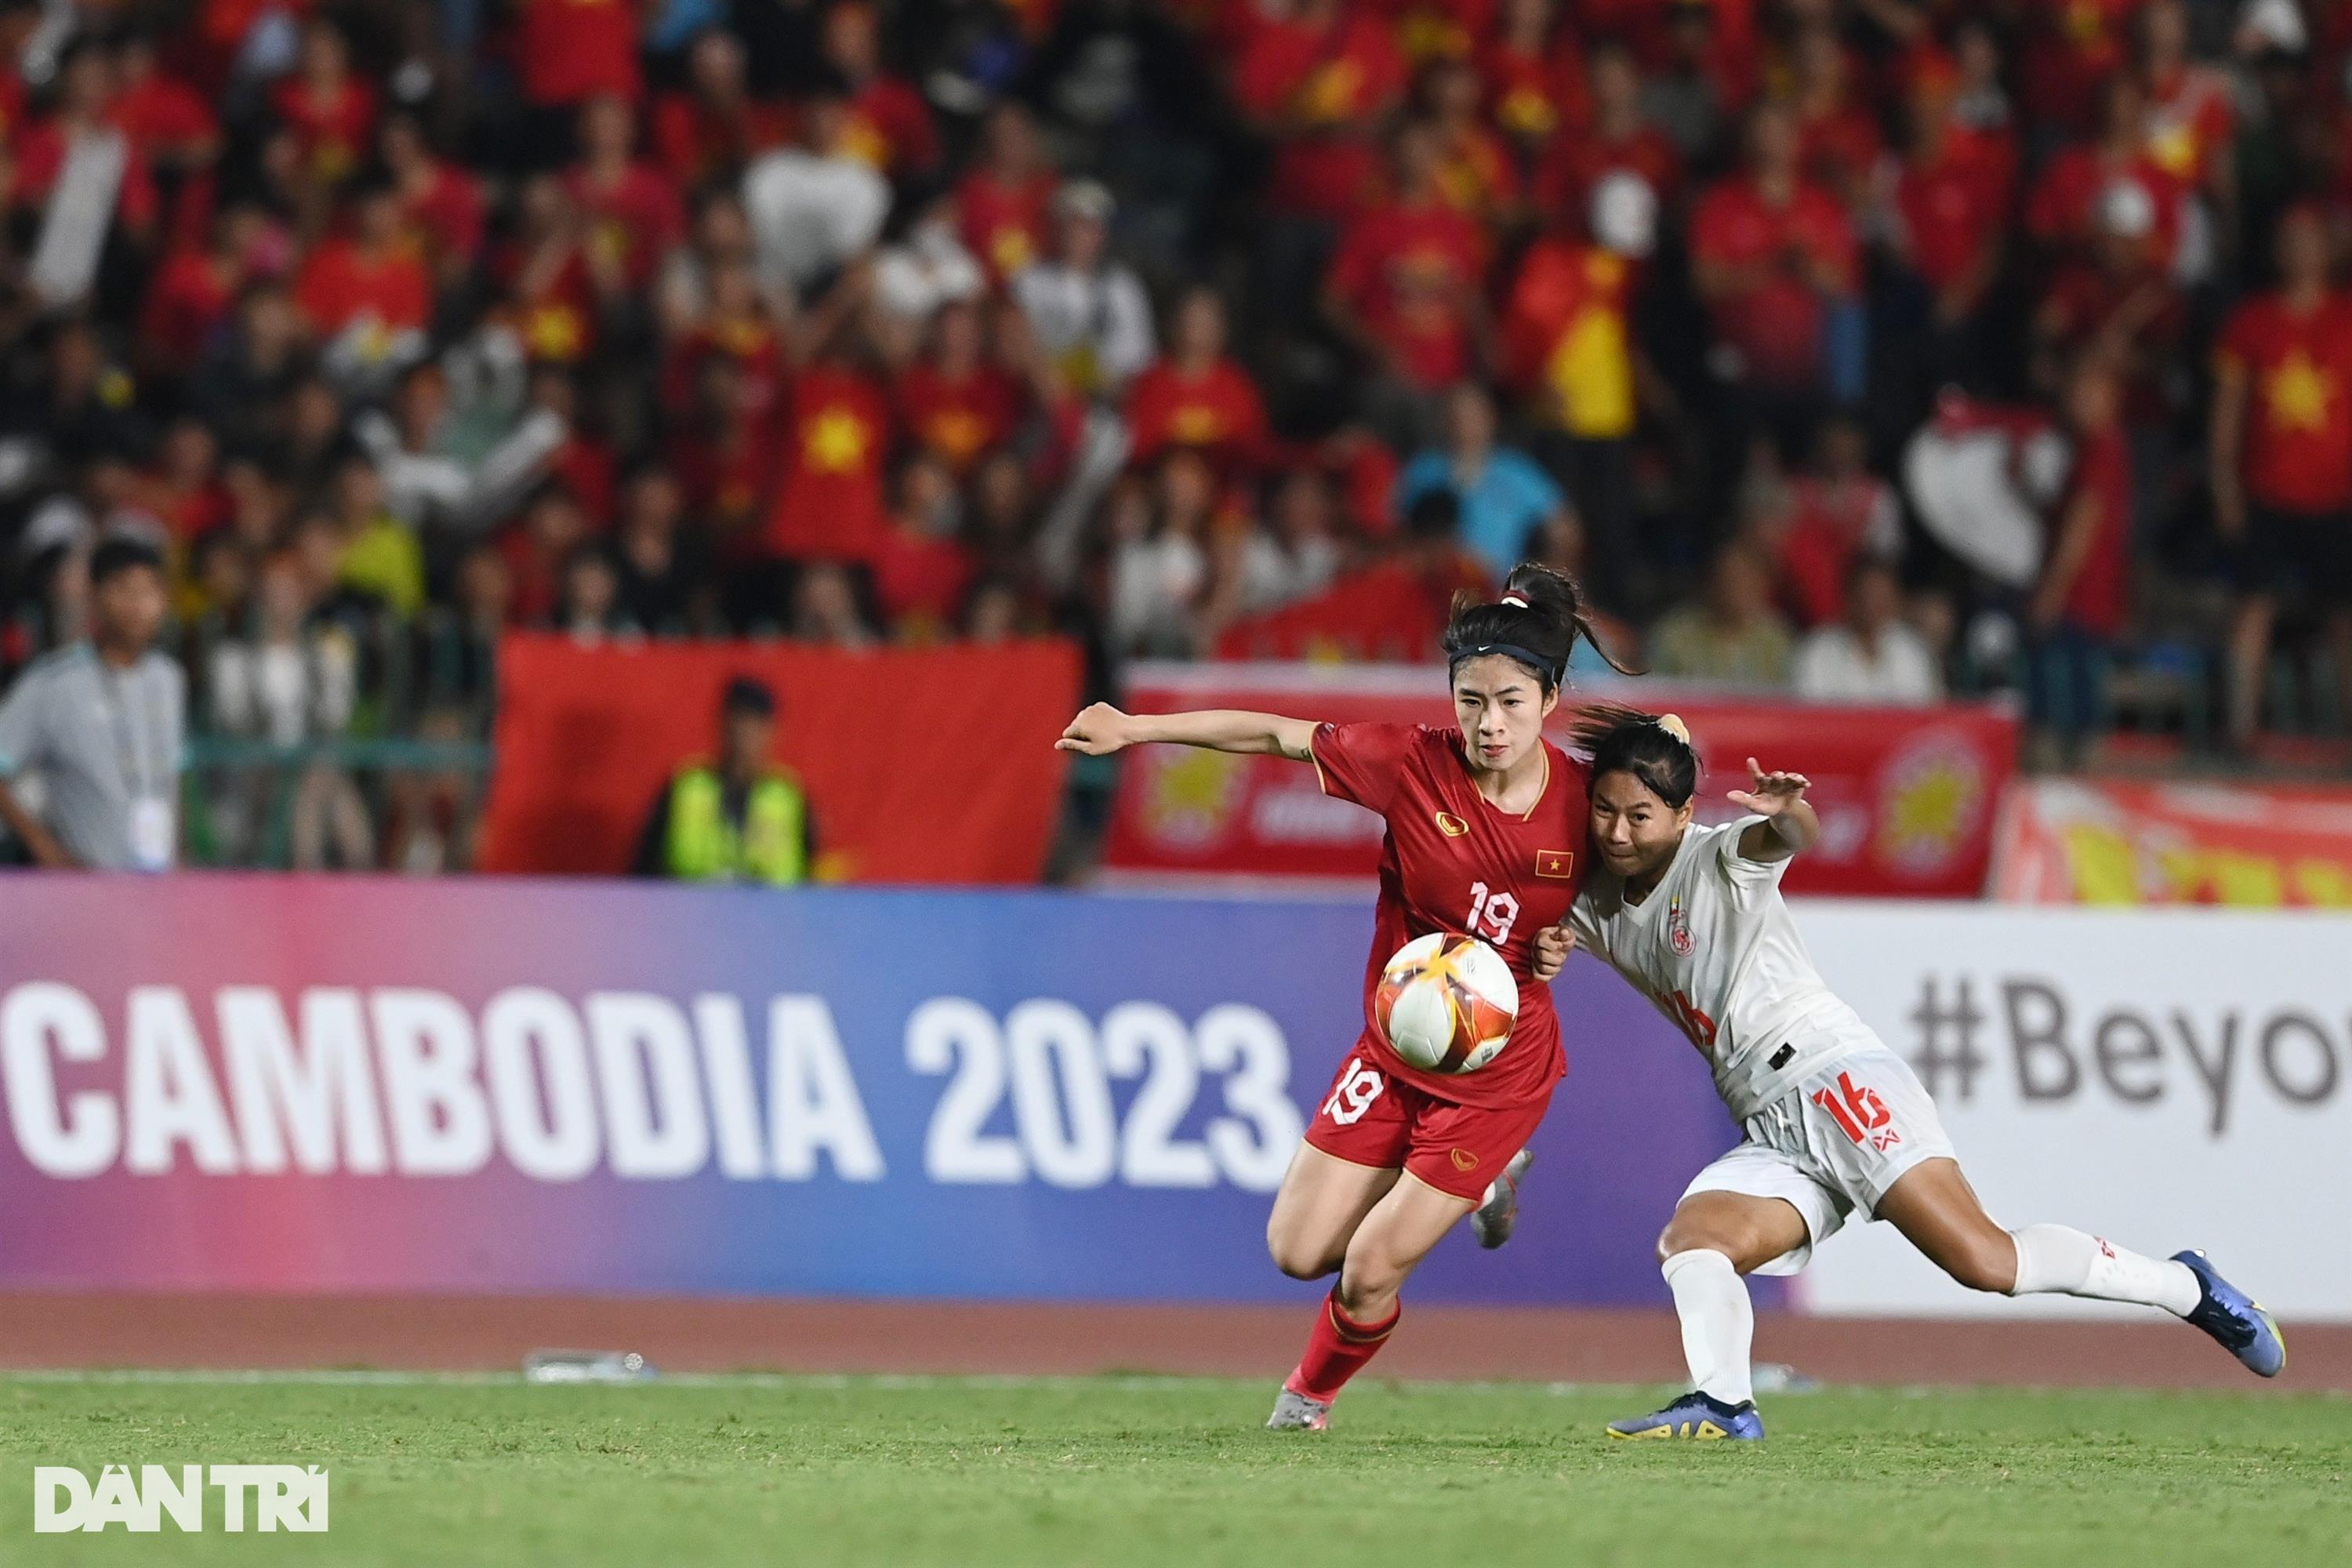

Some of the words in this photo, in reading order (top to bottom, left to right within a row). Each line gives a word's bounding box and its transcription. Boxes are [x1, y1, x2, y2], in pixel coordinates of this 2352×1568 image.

[1467, 881, 1519, 946] 19
[2, 982, 886, 1181] CAMBODIA
[905, 996, 1303, 1192] 2023
[1322, 1057, 1385, 1126] 19
[1910, 972, 2352, 1138] #Beyo
[1812, 1071, 1892, 1144] 16
